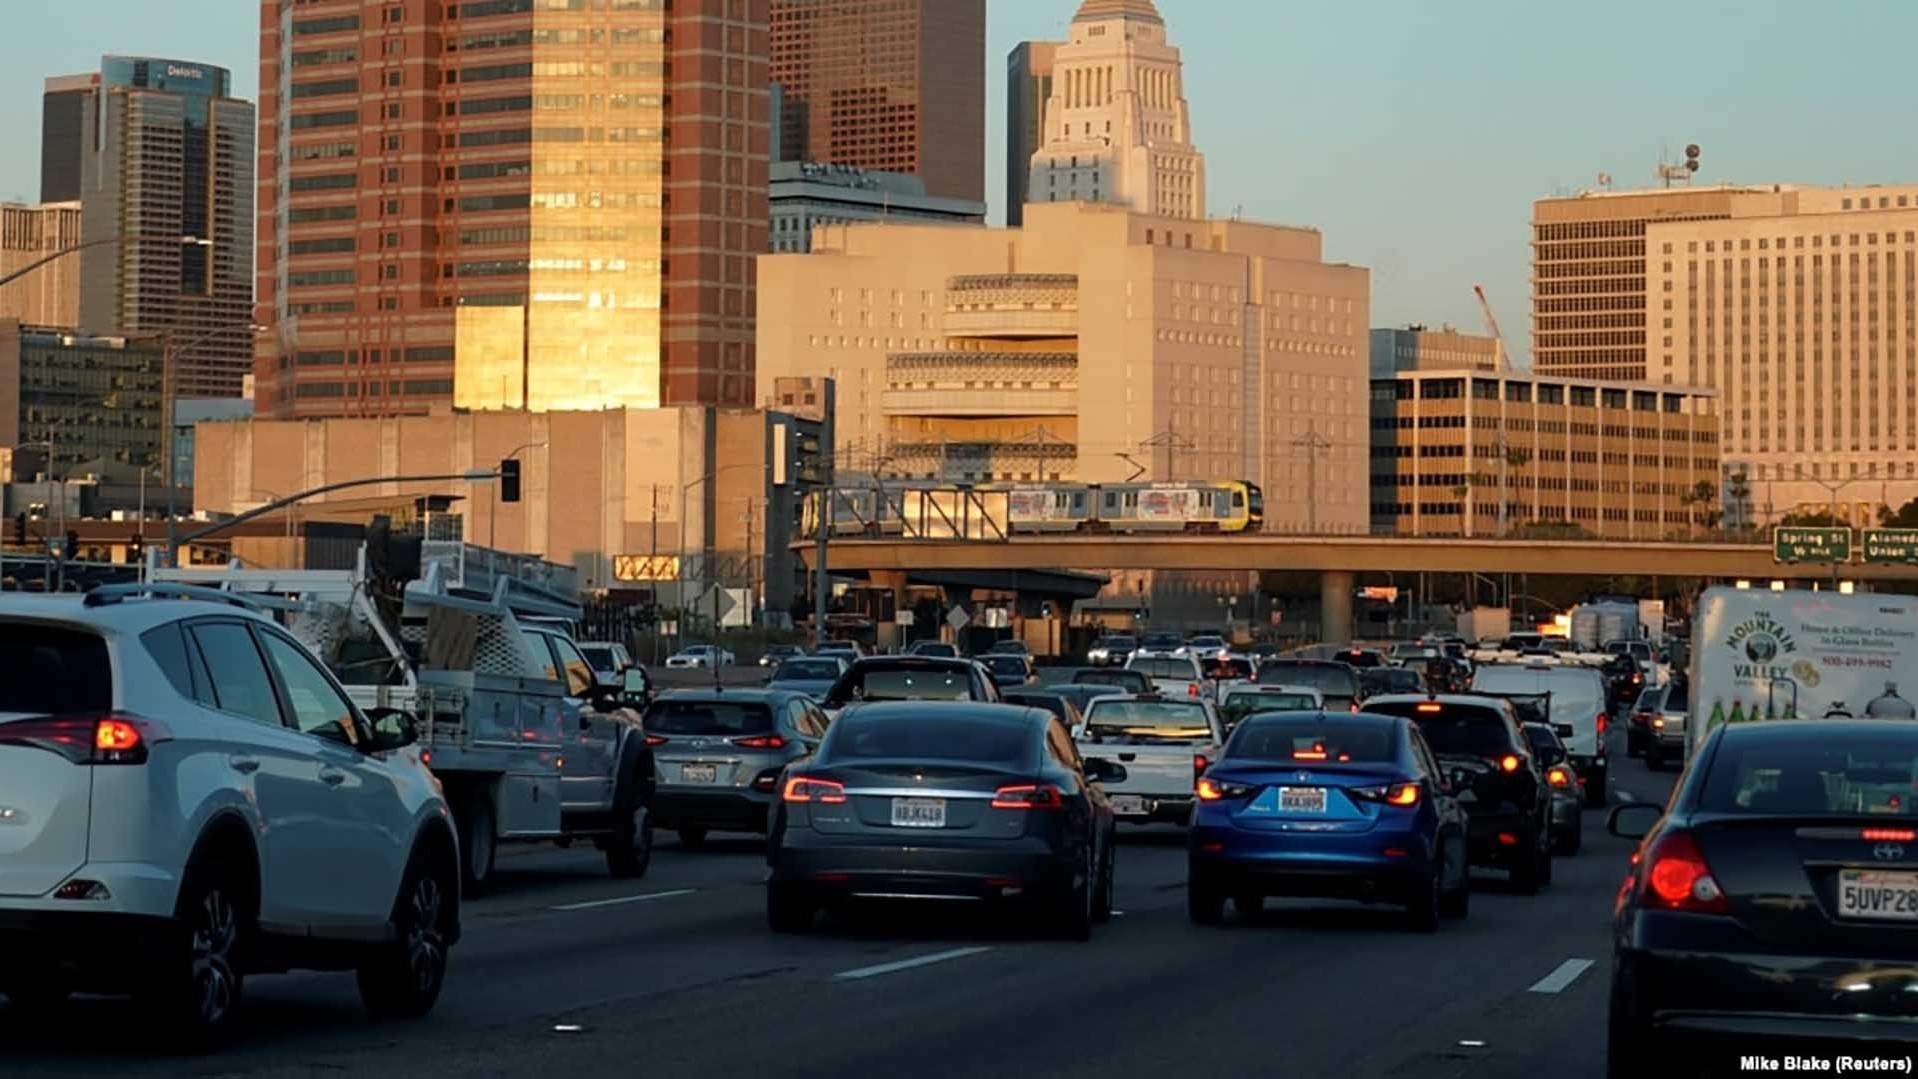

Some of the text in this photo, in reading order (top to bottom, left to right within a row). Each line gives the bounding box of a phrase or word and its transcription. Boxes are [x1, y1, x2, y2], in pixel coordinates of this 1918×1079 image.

[1781, 533, 1823, 546] Spring
[1869, 546, 1905, 556] Union
[1727, 619, 1797, 653] MOUNTAIN
[1734, 665, 1788, 680] VALLEY
